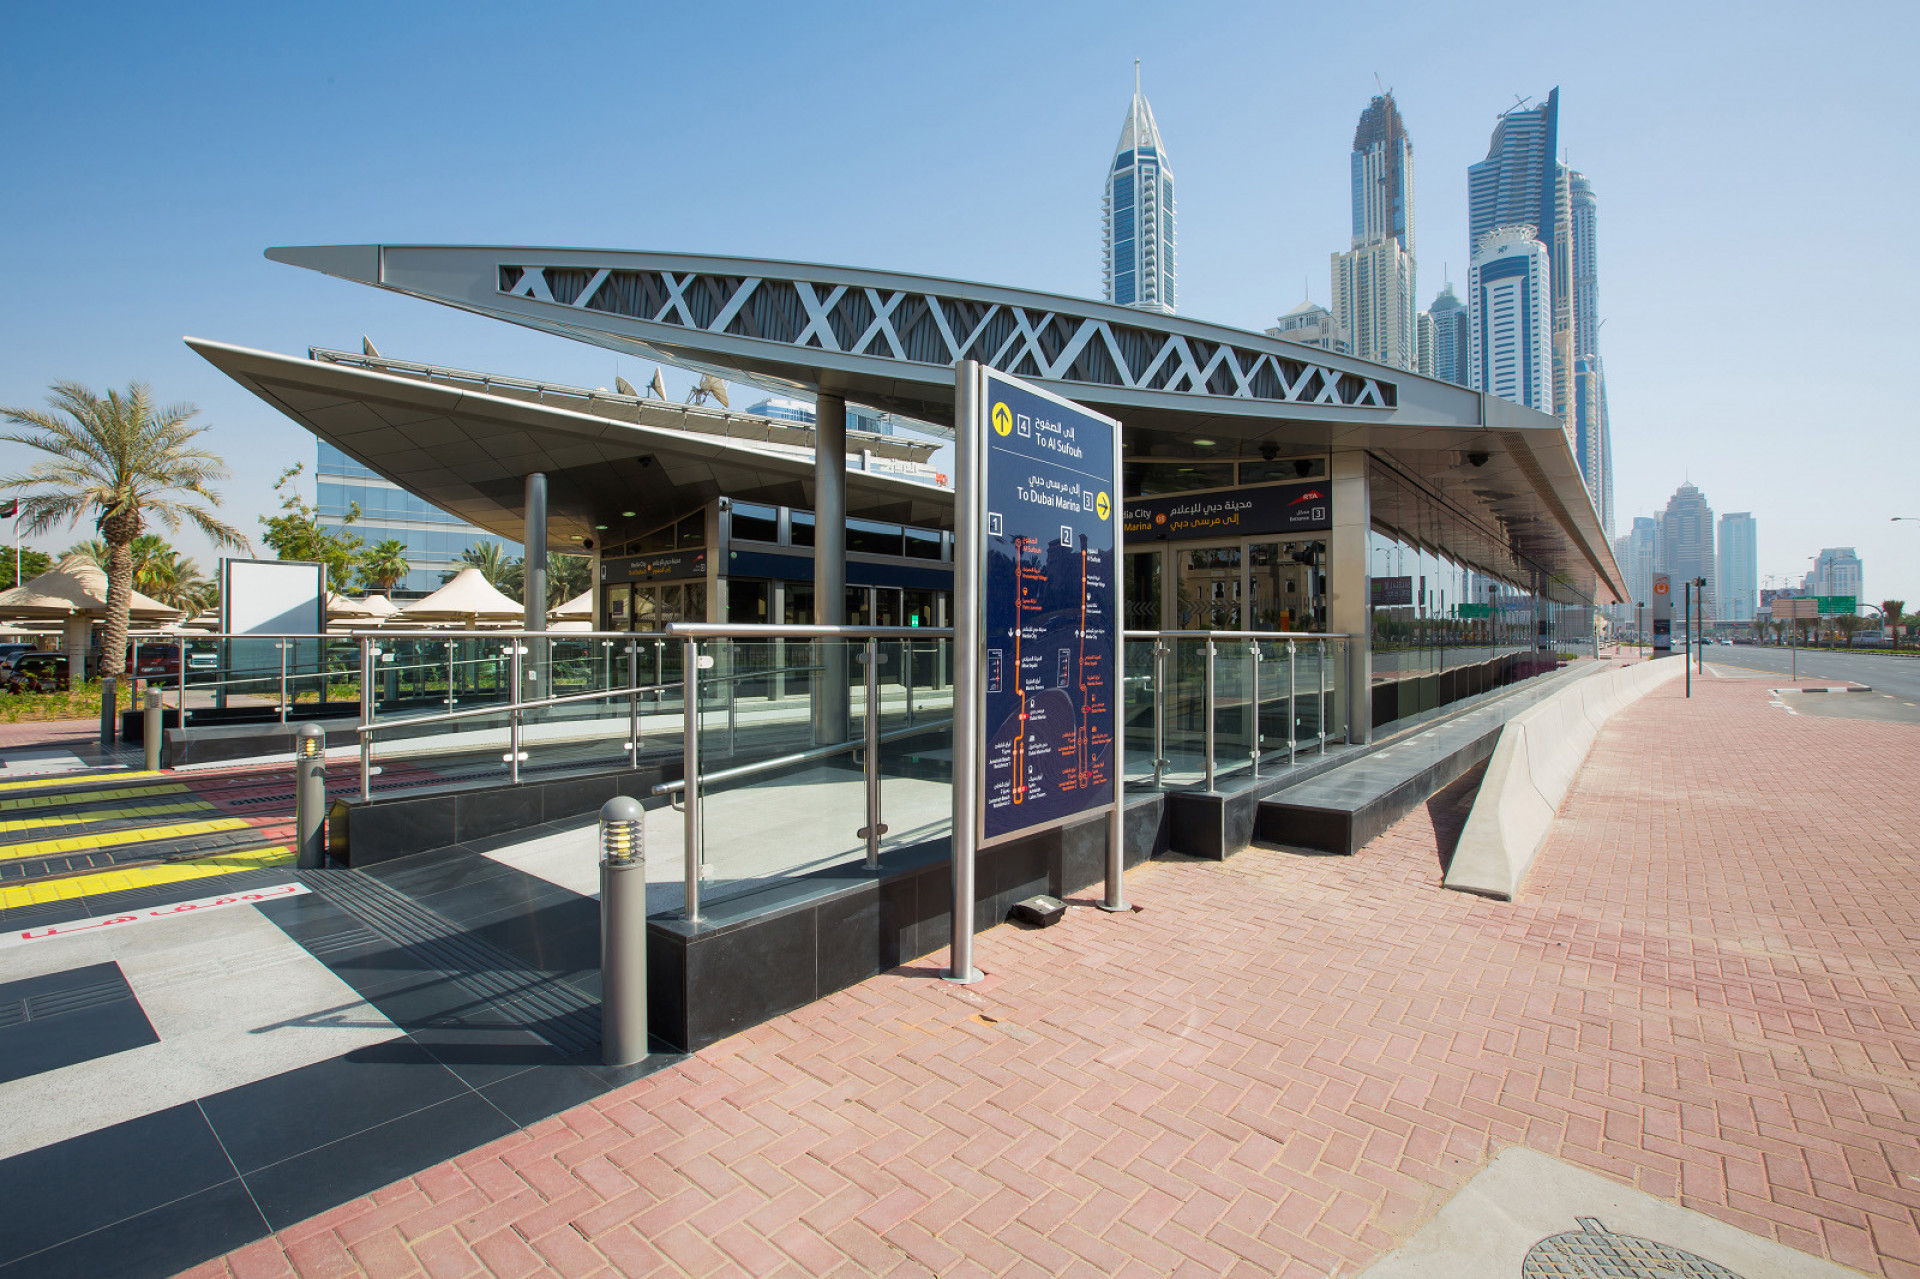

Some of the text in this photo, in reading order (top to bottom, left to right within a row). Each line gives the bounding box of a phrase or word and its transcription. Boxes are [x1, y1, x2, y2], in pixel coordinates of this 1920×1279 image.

[1020, 420, 1027, 433] 4
[1035, 416, 1062, 434] الصفوح
[1035, 432, 1083, 459] To Al Sufouh
[1017, 486, 1081, 513] To Dubai Marina
[1224, 500, 1253, 511] مدينة
[1134, 508, 1152, 520] City
[1202, 504, 1223, 515] دبي
[992, 517, 998, 531] 1
[1123, 521, 1152, 532] Marina
[1063, 529, 1070, 543] 2
[21, 885, 296, 940] توقف هنا
